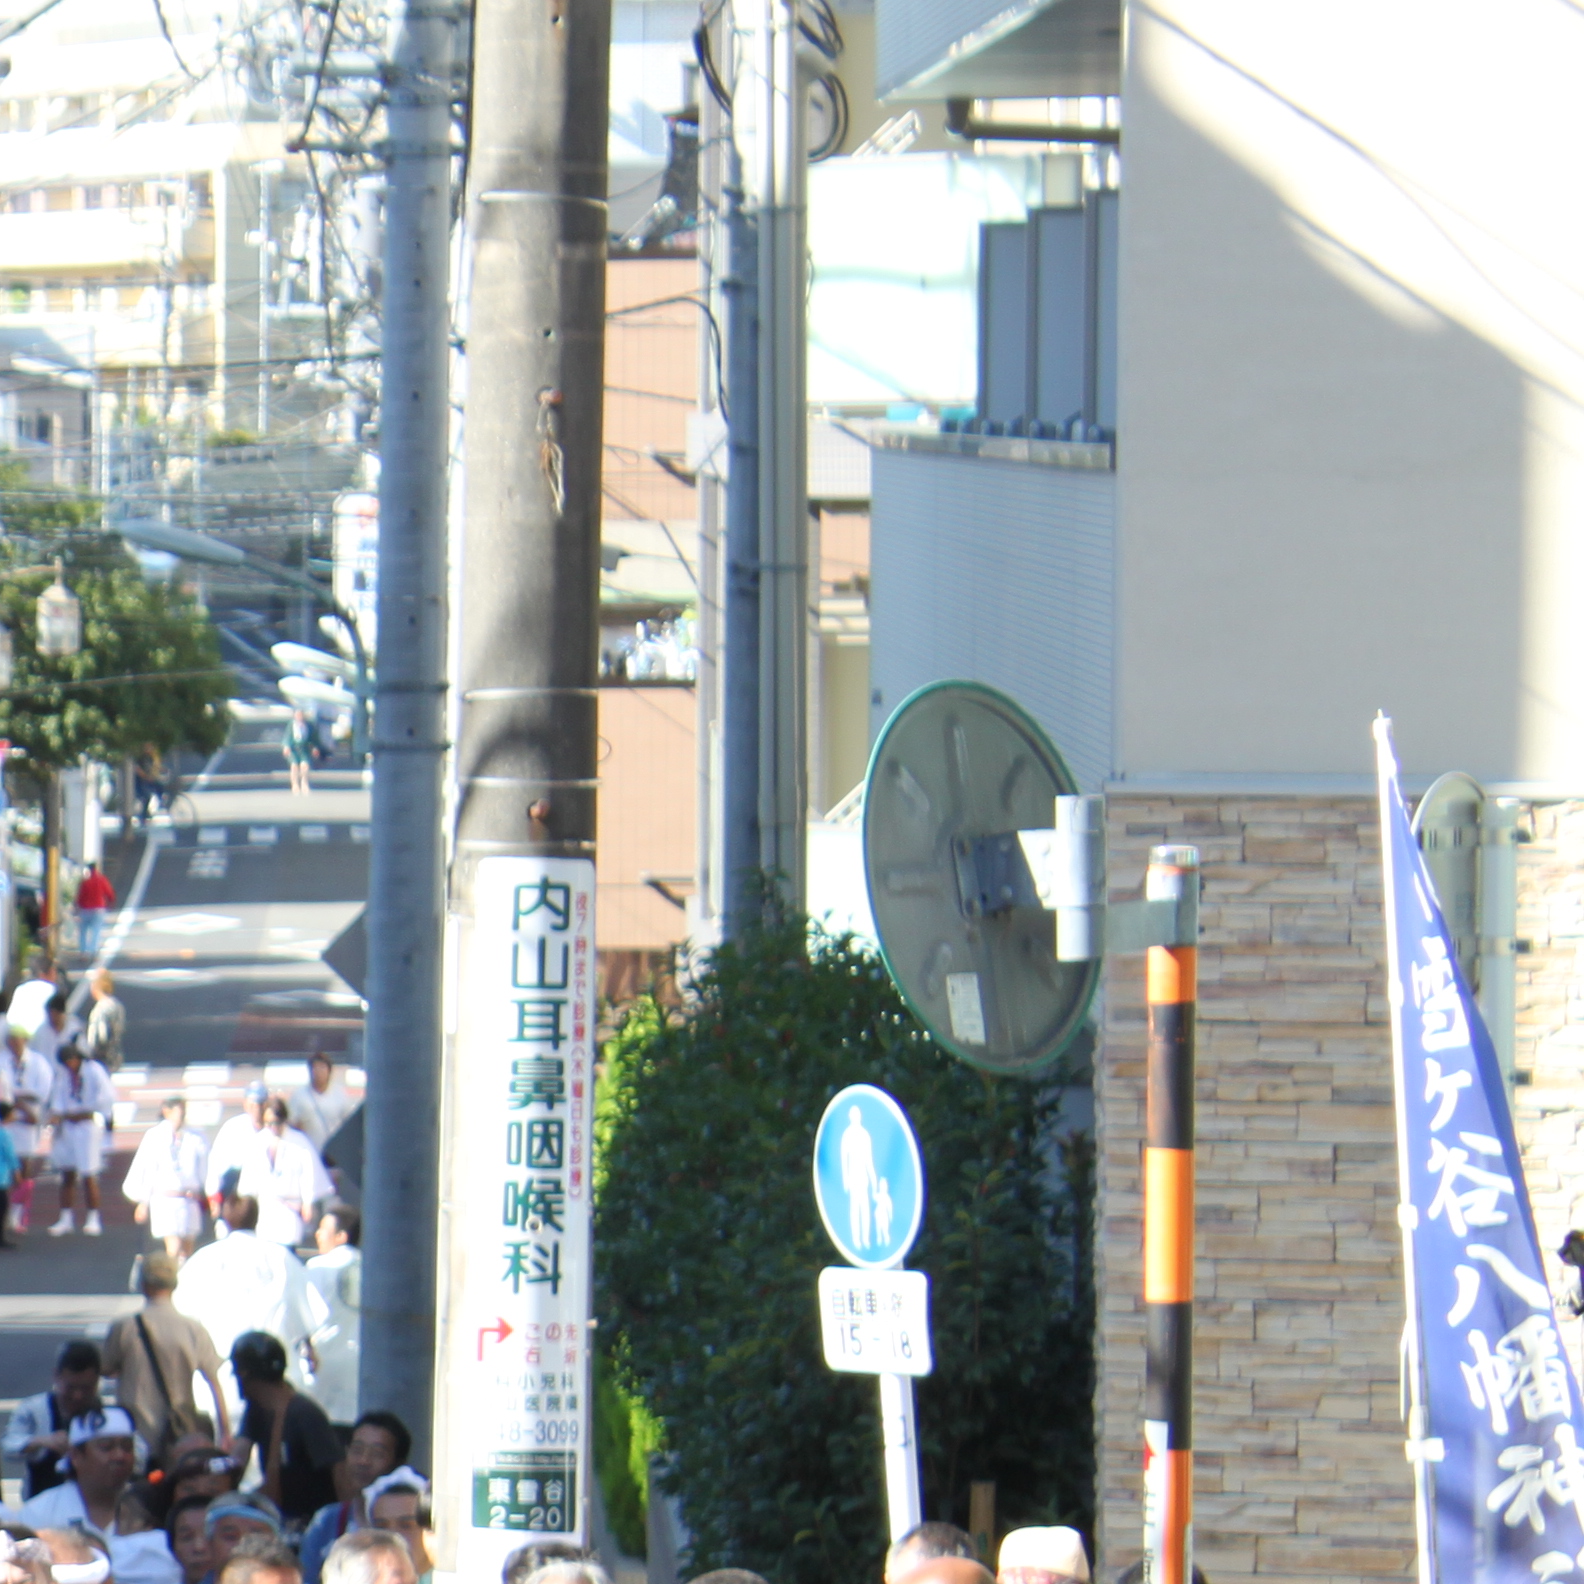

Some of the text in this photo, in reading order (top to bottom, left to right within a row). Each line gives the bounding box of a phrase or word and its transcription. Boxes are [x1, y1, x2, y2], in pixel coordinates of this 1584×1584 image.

[501, 874, 572, 1297] 内山耳鼻咽喉科
[489, 1505, 562, 1531] 2-20
